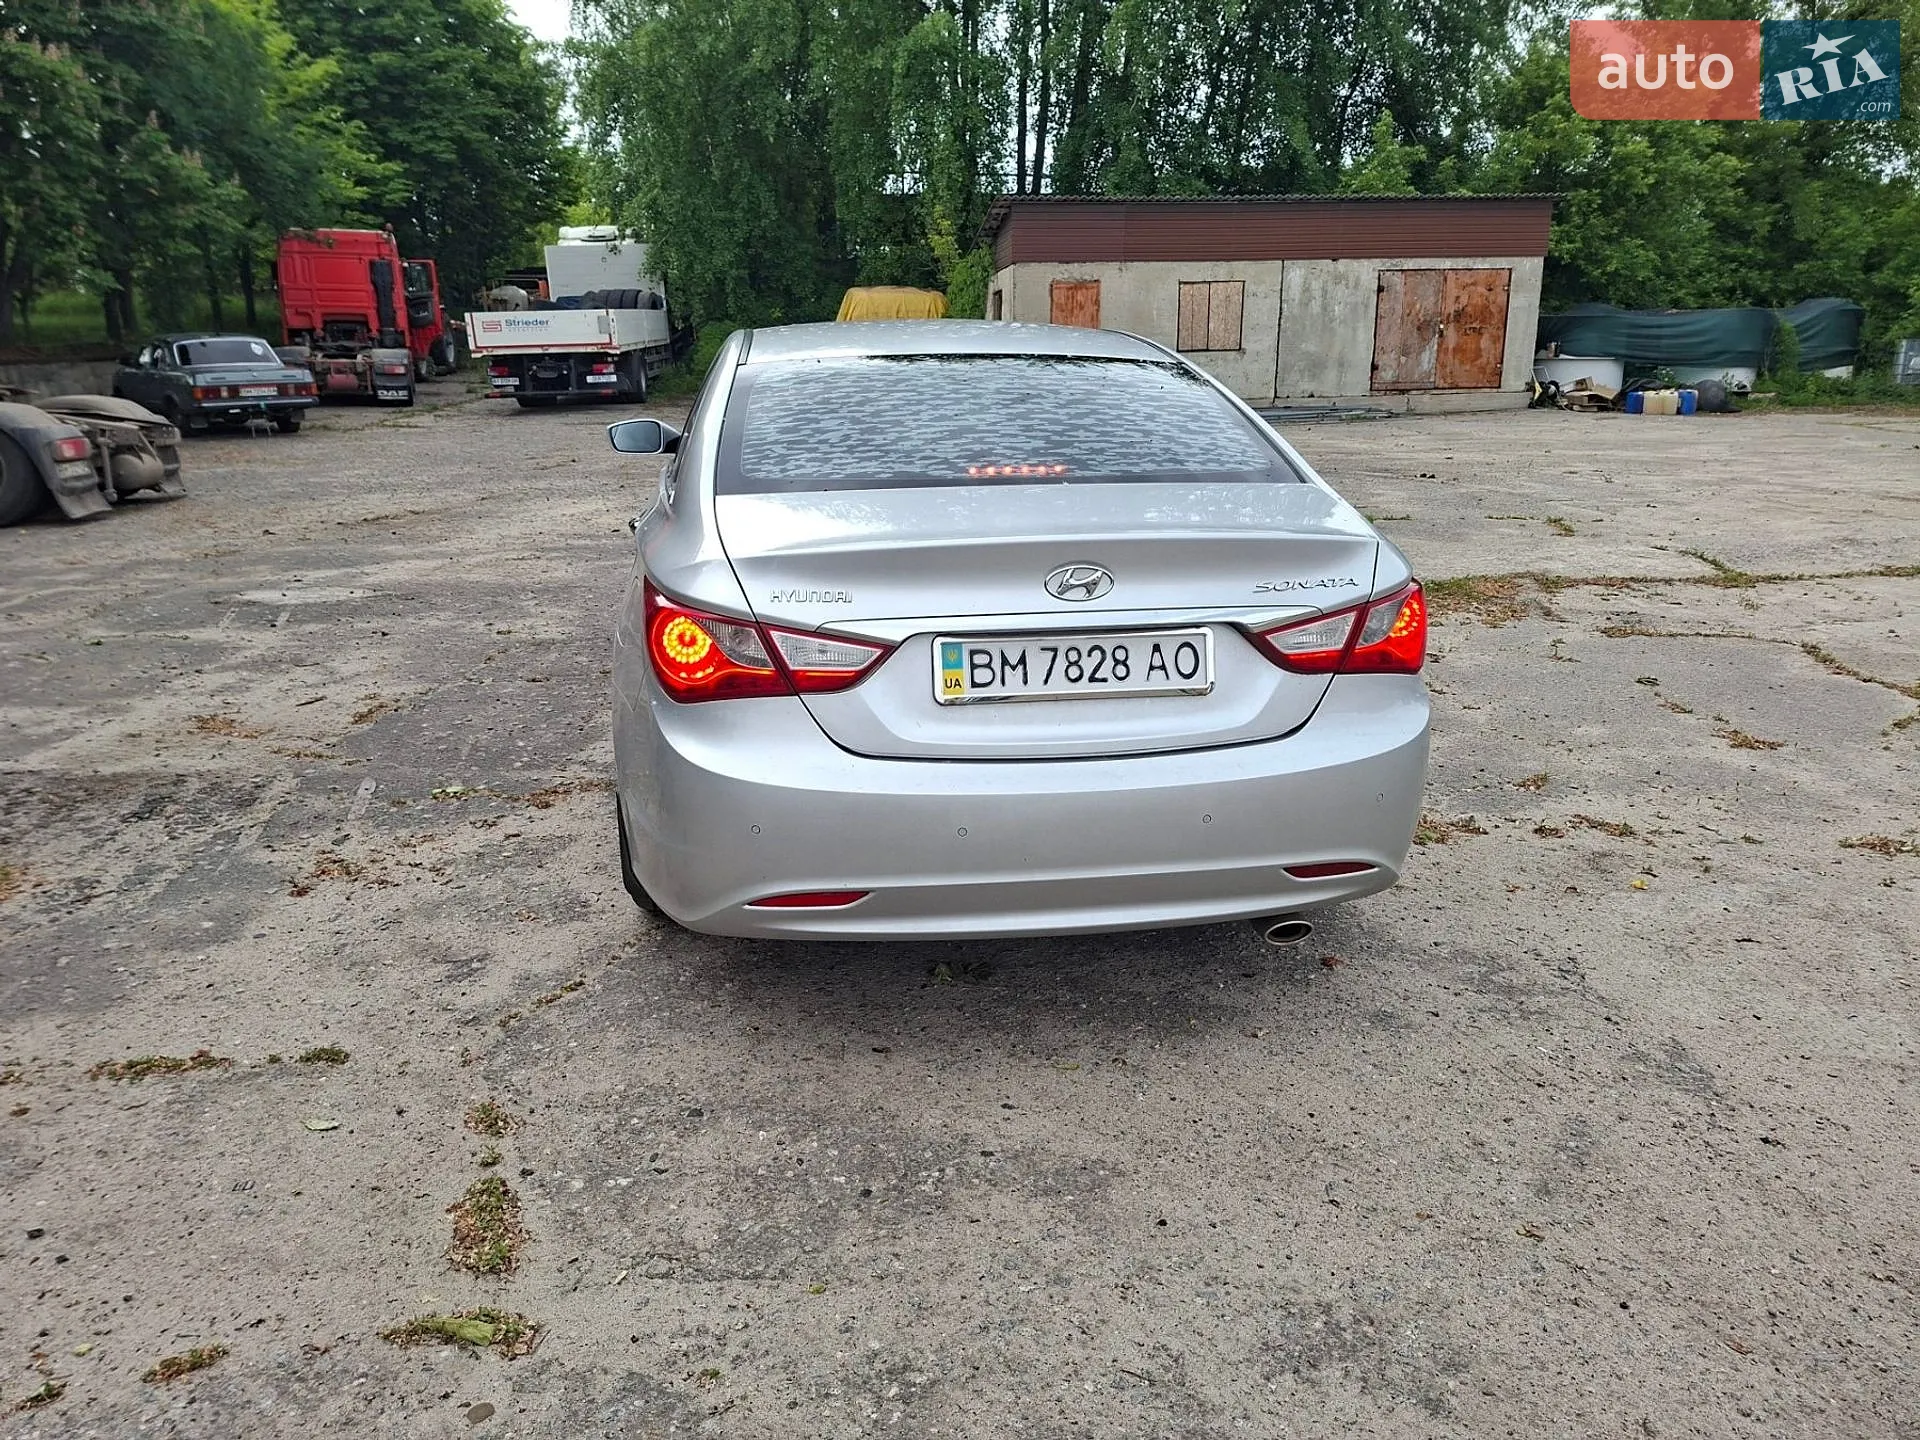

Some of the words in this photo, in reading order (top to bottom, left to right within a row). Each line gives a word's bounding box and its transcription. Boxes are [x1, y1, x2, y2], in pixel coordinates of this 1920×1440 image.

[505, 318, 550, 327] Strieder
[1253, 577, 1359, 593] SONATA
[770, 588, 853, 603] HYUNDAI
[969, 648, 1029, 688] BM
[1040, 645, 1131, 686] 7828
[1146, 641, 1200, 681] AO
[944, 678, 962, 689] UA
